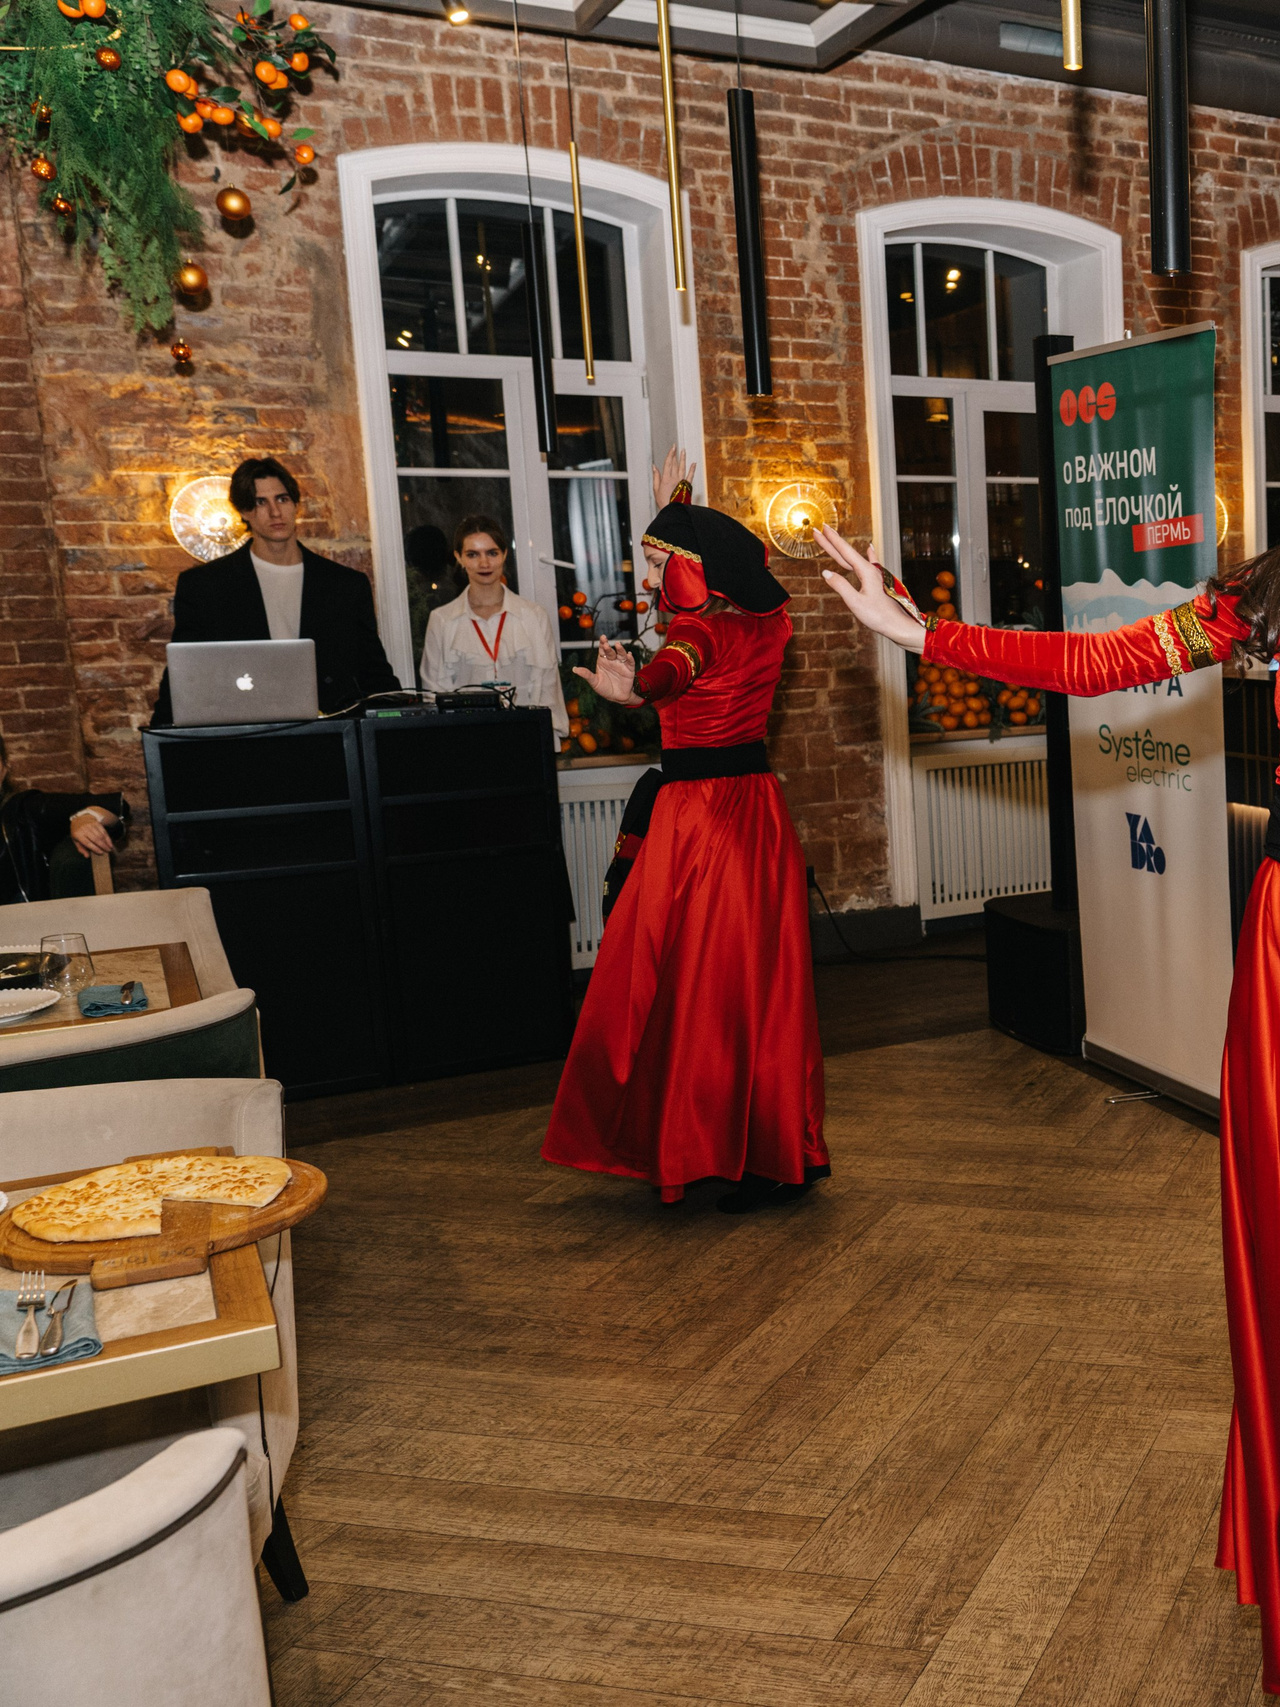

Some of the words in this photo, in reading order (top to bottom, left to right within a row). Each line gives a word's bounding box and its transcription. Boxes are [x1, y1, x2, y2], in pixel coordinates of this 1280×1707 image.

[1059, 382, 1116, 427] OCS
[1063, 461, 1073, 485] о
[1074, 446, 1157, 484] ВАЖНОМ
[1065, 506, 1093, 531] под
[1094, 483, 1183, 527] ЁЛОЧКОЙ
[1146, 521, 1191, 546] ПЕРМЬ
[1098, 724, 1191, 767] Systême
[1126, 759, 1193, 792] electric
